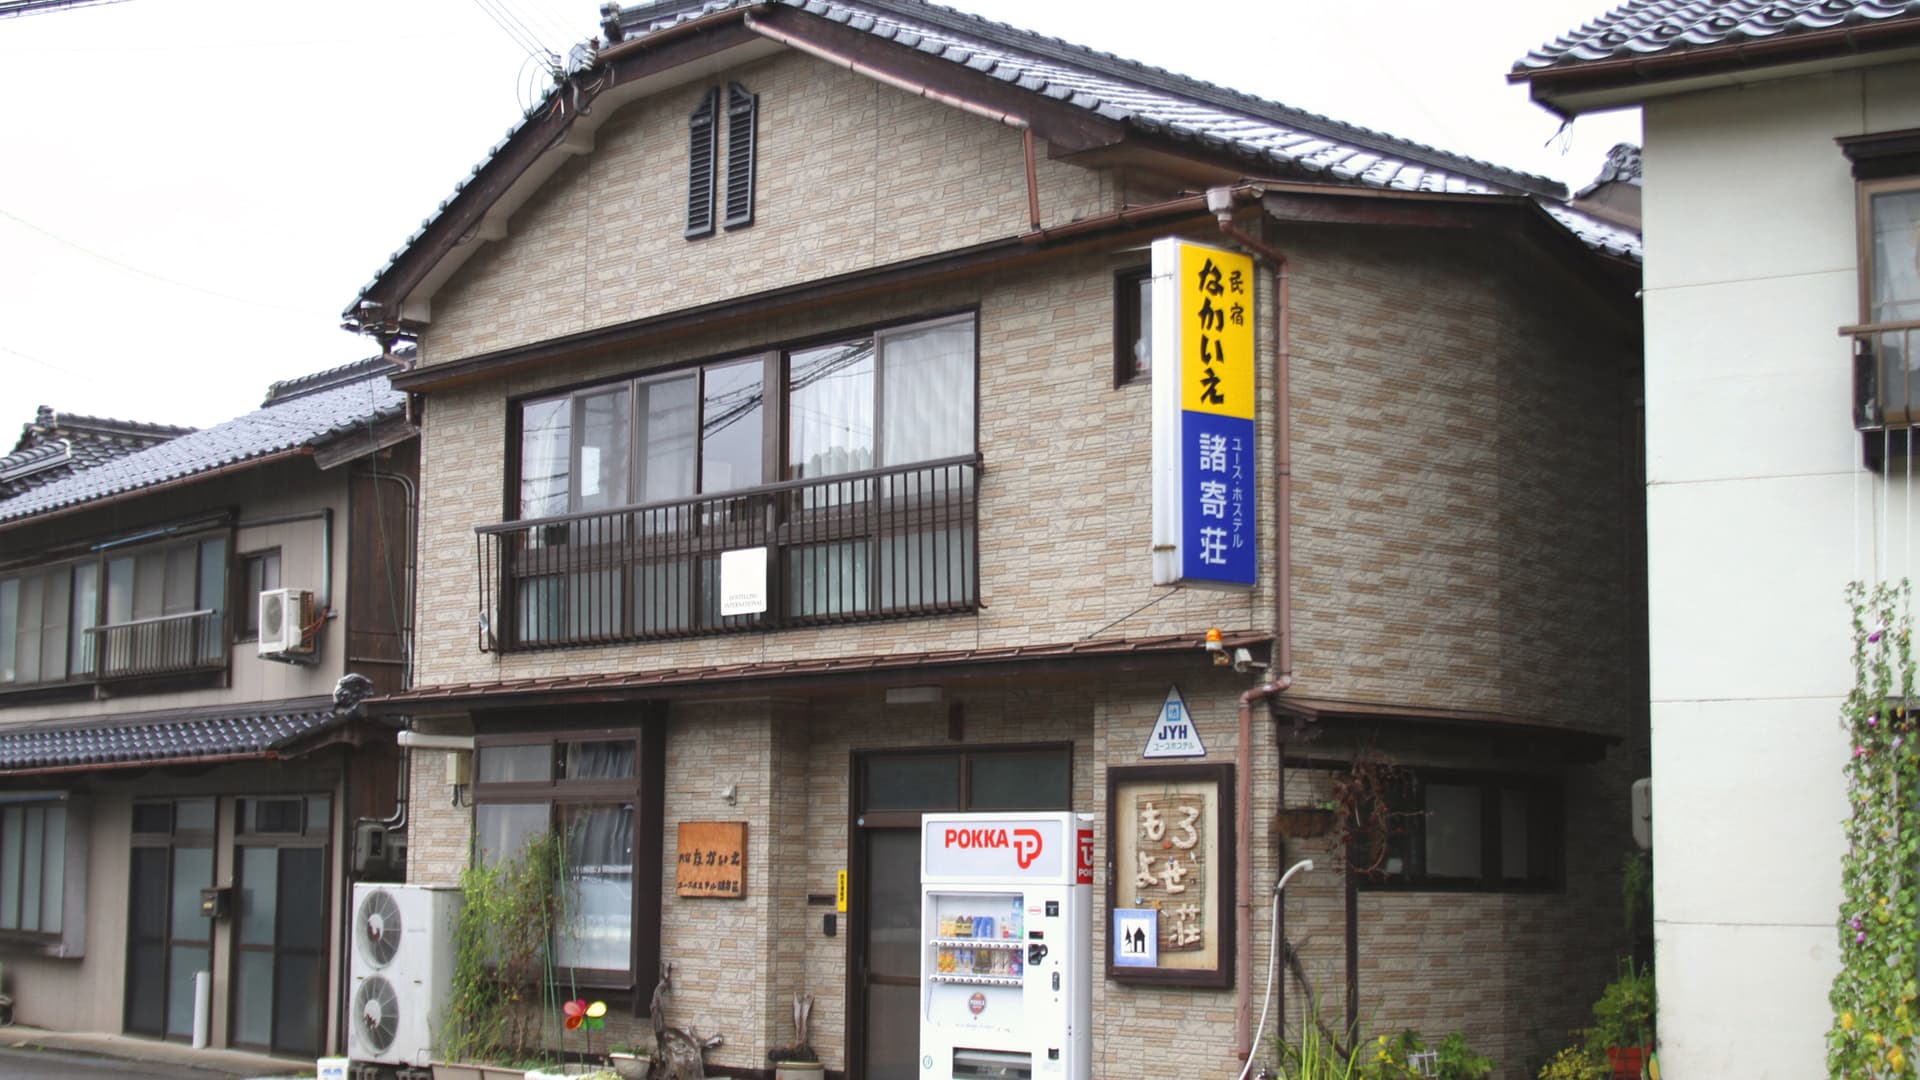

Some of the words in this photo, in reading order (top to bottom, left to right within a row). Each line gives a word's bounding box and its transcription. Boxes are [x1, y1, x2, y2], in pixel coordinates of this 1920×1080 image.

[1229, 270, 1244, 327] 民宿
[1198, 258, 1225, 405] なかいえ
[1200, 433, 1227, 565] 諸寄荘
[1158, 724, 1188, 740] JYH
[945, 828, 1009, 848] POKKA
[1169, 904, 1201, 946] 荘
